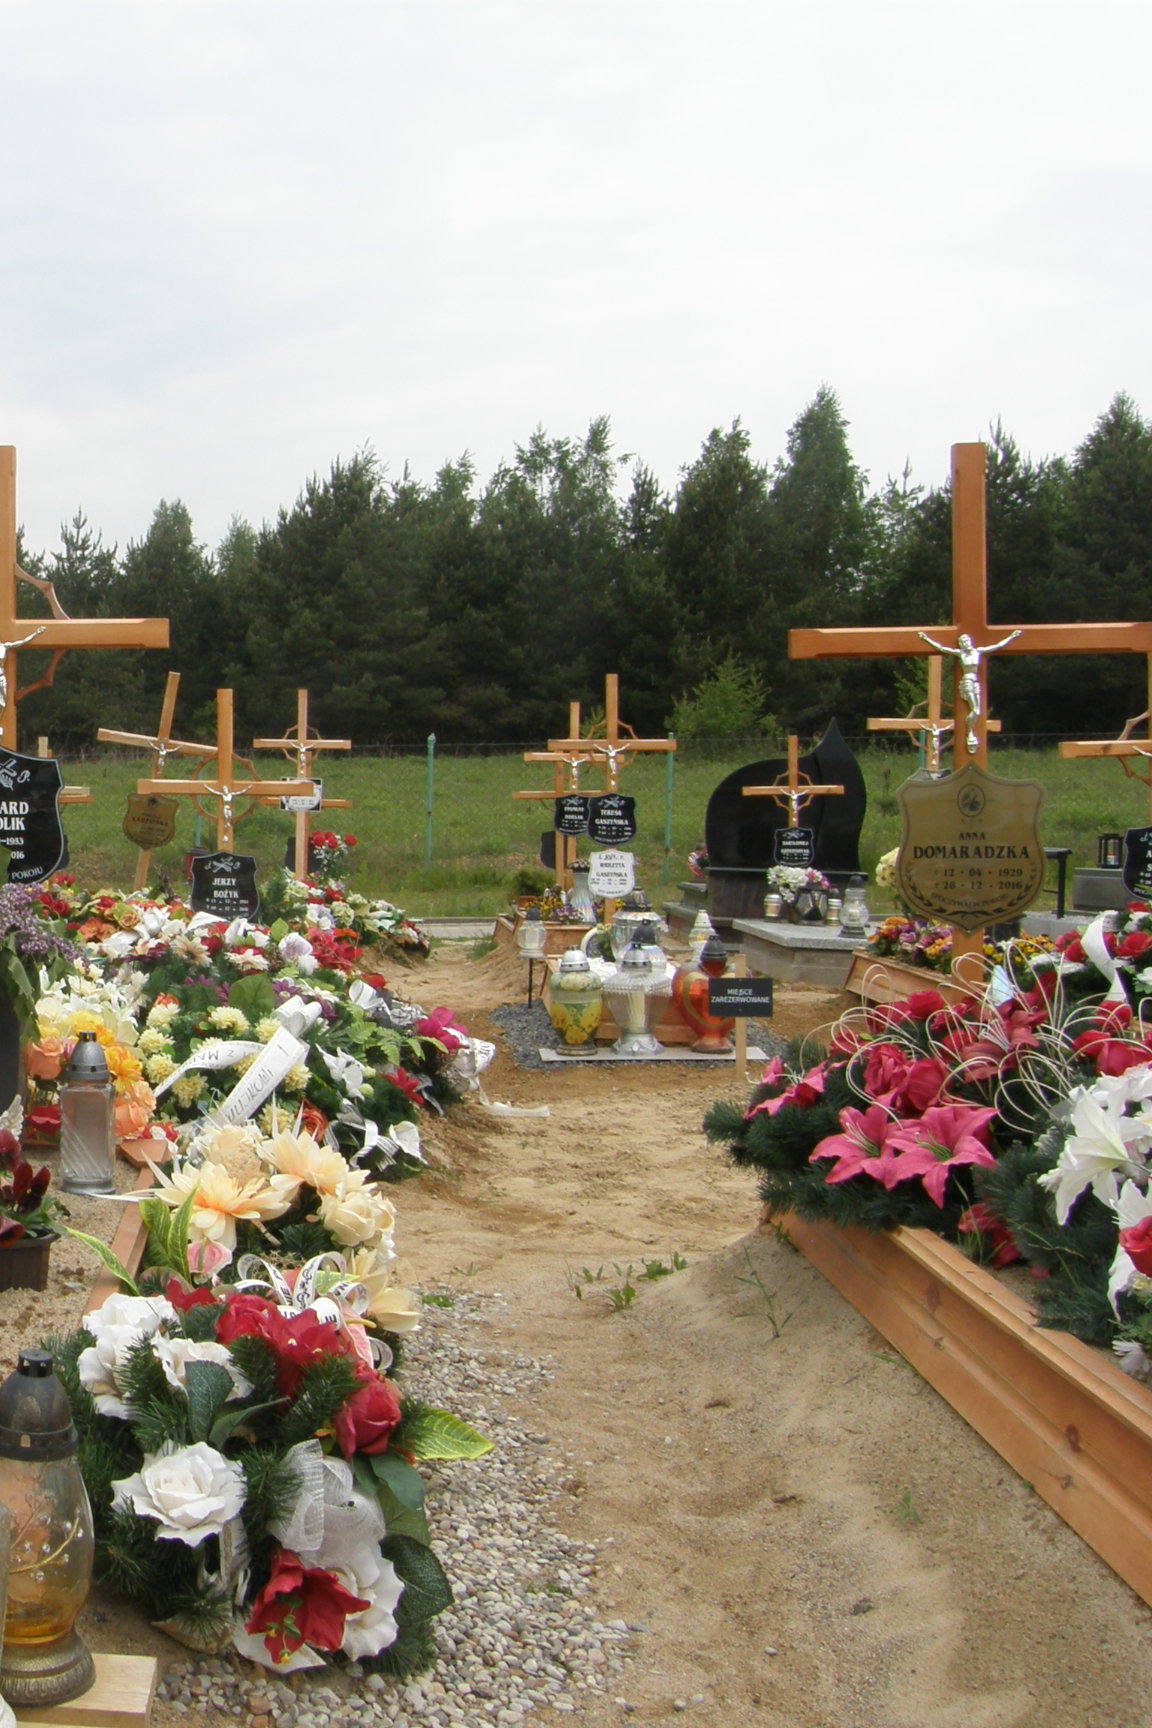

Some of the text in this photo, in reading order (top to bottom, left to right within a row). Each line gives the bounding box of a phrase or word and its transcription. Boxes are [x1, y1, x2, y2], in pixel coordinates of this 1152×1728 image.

[958, 832, 986, 840] ANNA
[913, 845, 1029, 859] DOMARADZKA
[212, 878, 237, 886] JERZY
[727, 988, 753, 996] MIEJSCE
